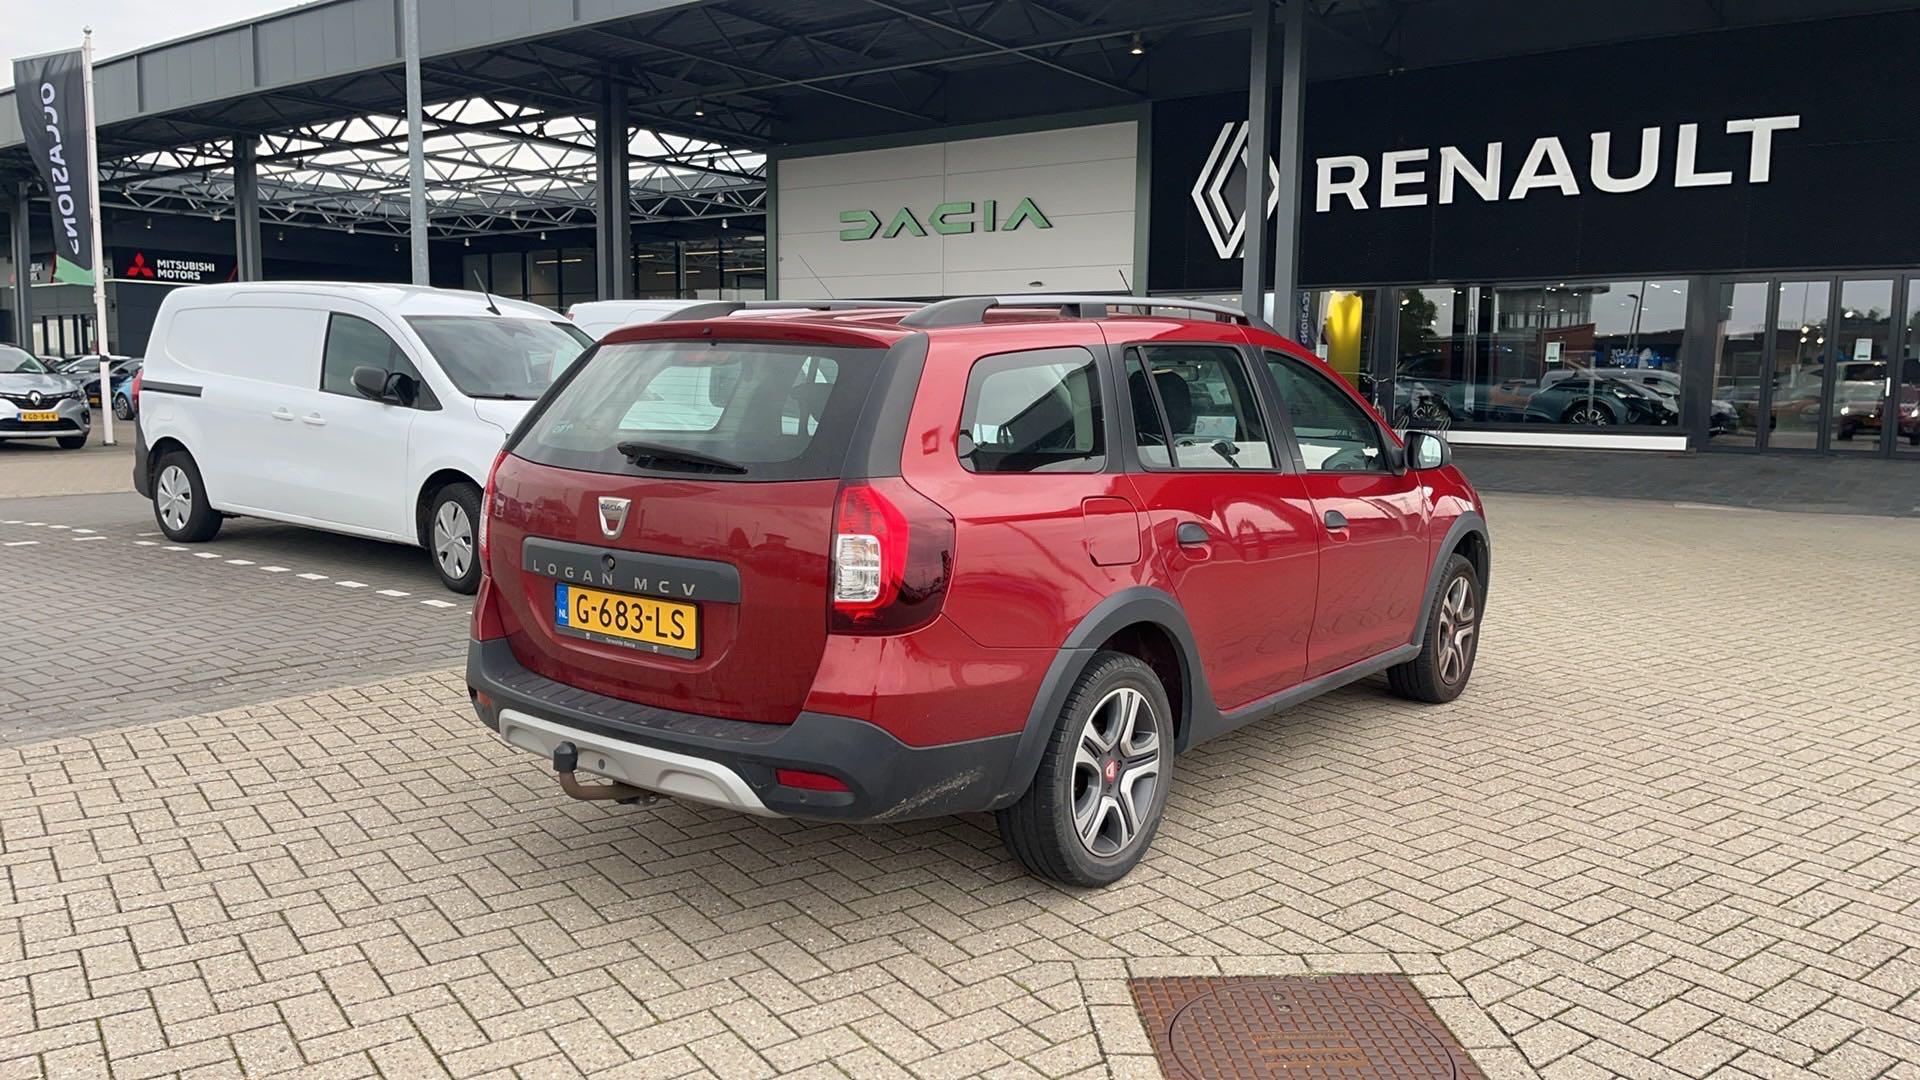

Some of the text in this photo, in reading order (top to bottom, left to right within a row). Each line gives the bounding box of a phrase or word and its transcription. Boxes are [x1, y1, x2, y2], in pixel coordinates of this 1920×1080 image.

[1316, 115, 1799, 212] RENAULT
[840, 197, 1052, 241] DACIA
[157, 259, 215, 272] MITSUBISHI
[157, 270, 201, 281] MOTORS
[533, 560, 695, 597] LOGAN MCV
[558, 608, 568, 620] NL
[576, 593, 686, 641] G-683-LS
